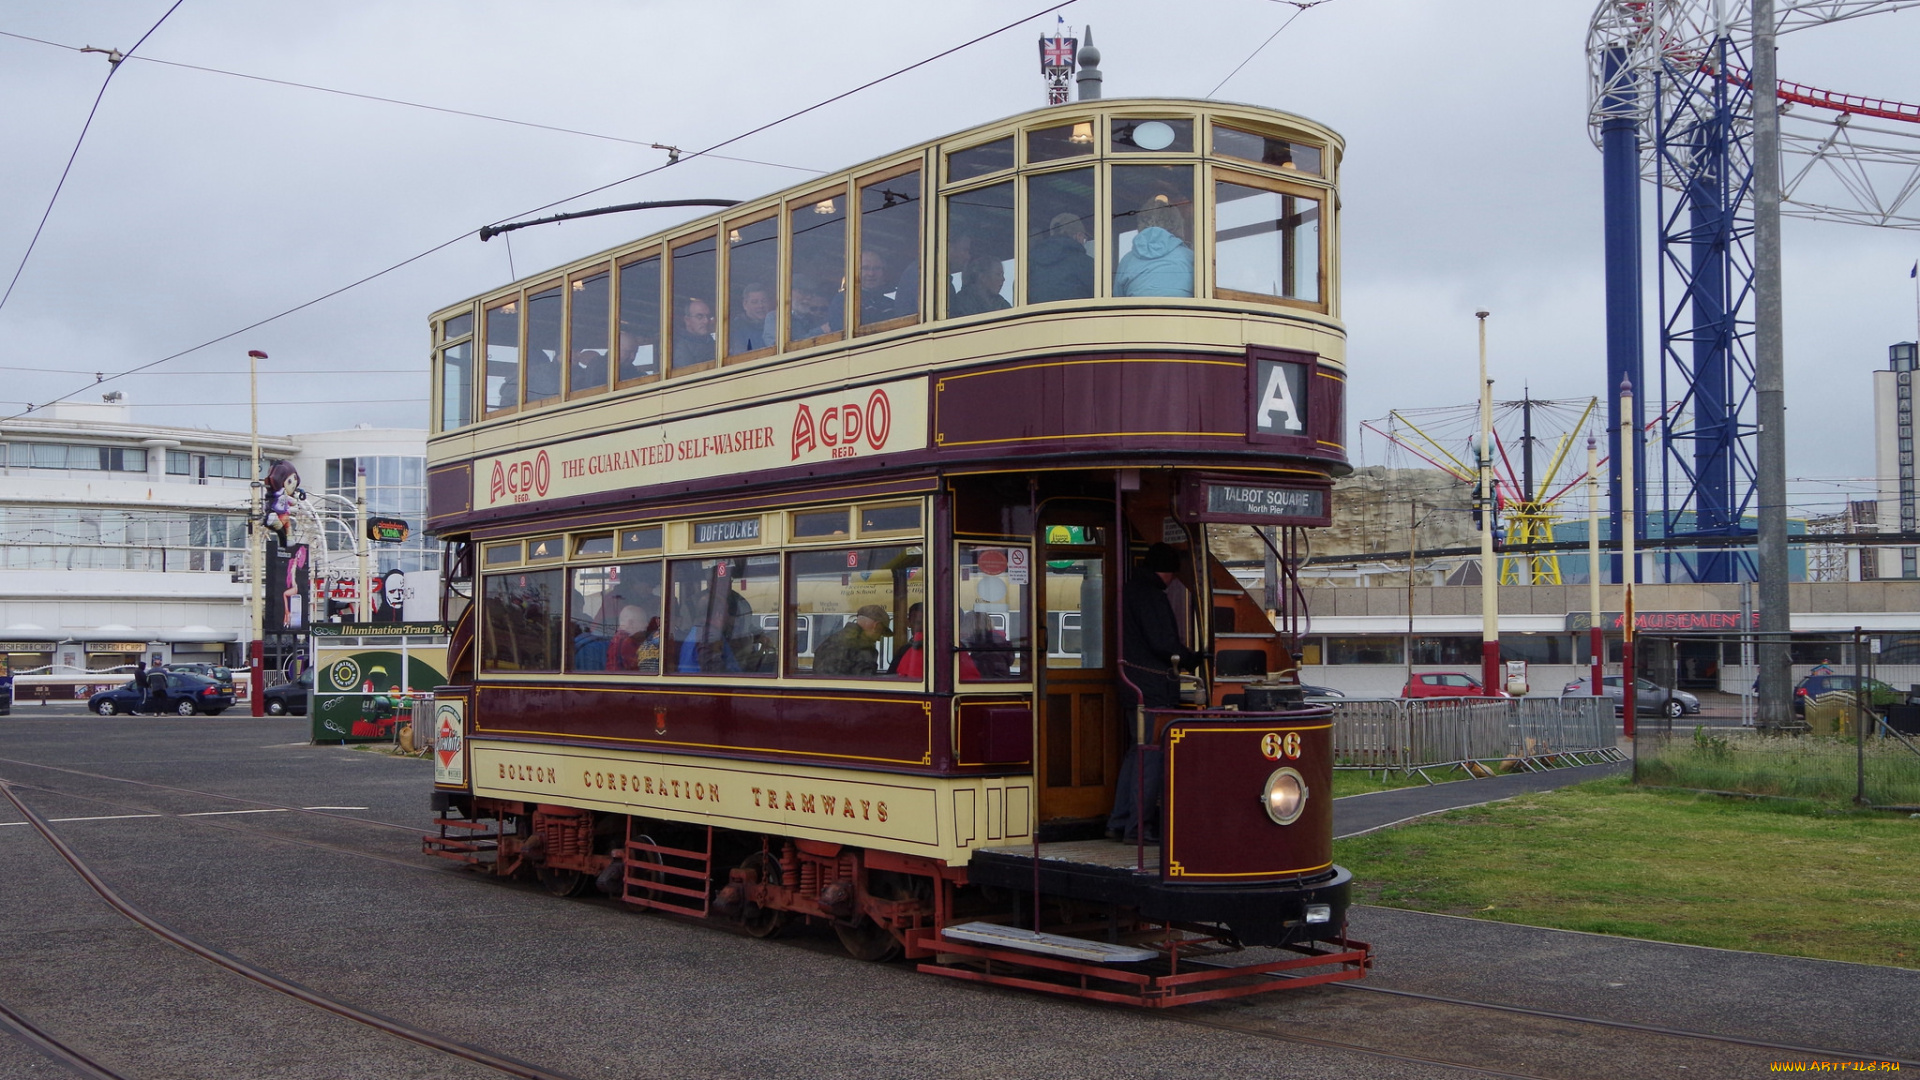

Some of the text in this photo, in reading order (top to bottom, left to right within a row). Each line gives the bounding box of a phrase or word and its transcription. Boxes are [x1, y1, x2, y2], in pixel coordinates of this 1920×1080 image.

[1257, 365, 1302, 431] A
[791, 388, 891, 461] ACDO
[562, 427, 775, 479] THE GUARANTEED SELF-WASHER
[490, 449, 550, 504] ACDO
[1224, 487, 1310, 507] TALBOT SQUARE
[1248, 503, 1284, 514] North Pier
[700, 519, 758, 542] DOFFCOCKER
[341, 625, 403, 635] Illumination
[402, 625, 430, 635] Tram
[1261, 731, 1302, 761] 66
[498, 763, 889, 823] BOLTON CORPORATION TRAMWAYS
